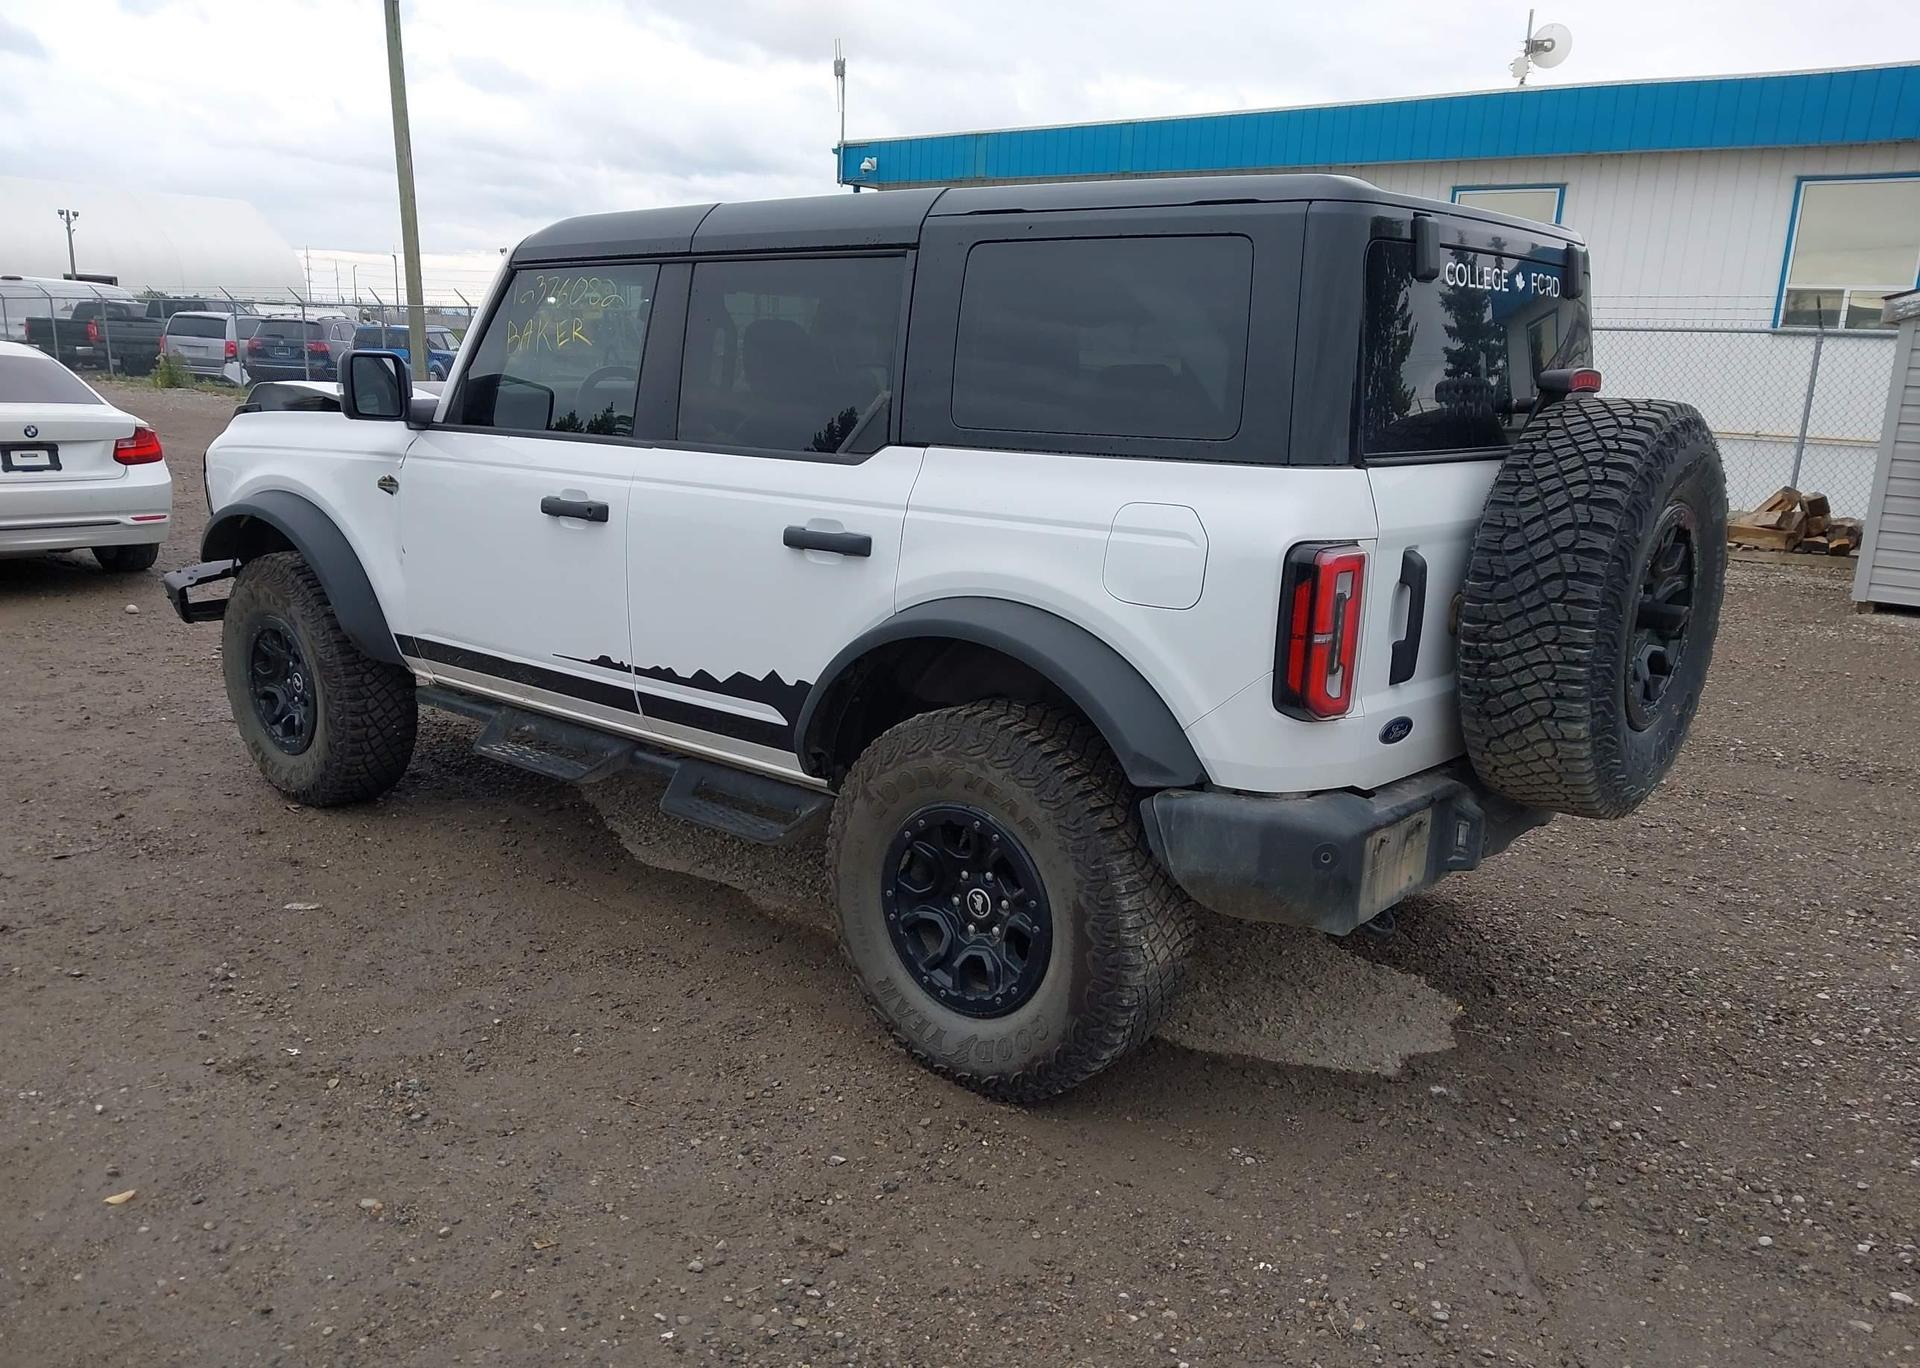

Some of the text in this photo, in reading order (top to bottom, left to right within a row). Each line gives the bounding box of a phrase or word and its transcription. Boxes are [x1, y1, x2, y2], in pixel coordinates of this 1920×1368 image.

[1445, 262, 1560, 298] COLLEGE FORD
[507, 317, 592, 353] BAKER
